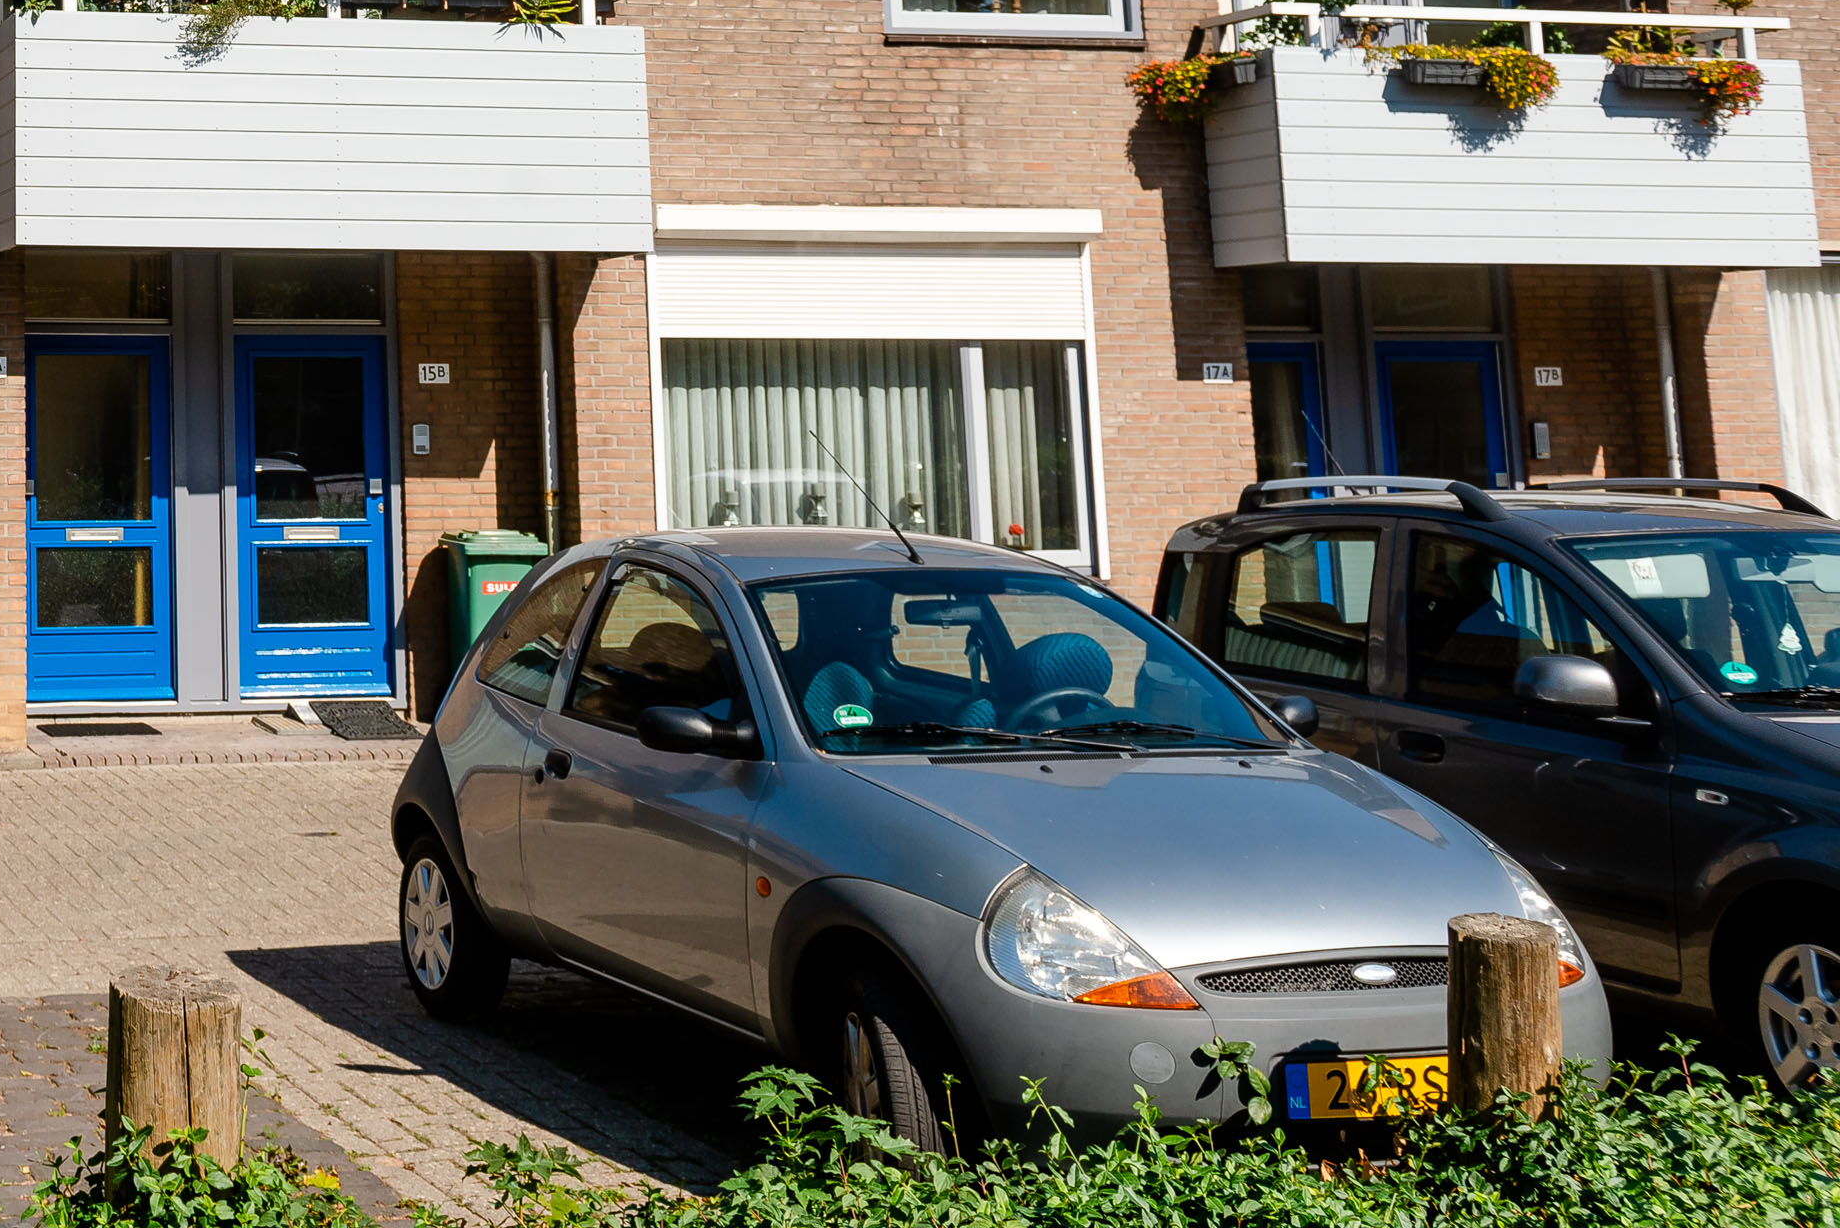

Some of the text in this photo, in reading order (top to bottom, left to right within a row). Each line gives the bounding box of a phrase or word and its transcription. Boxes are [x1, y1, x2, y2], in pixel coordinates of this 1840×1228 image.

[422, 365, 446, 381] 15B
[1206, 365, 1230, 380] 17A
[1538, 369, 1560, 384] 17B
[1290, 1096, 1307, 1109] NL
